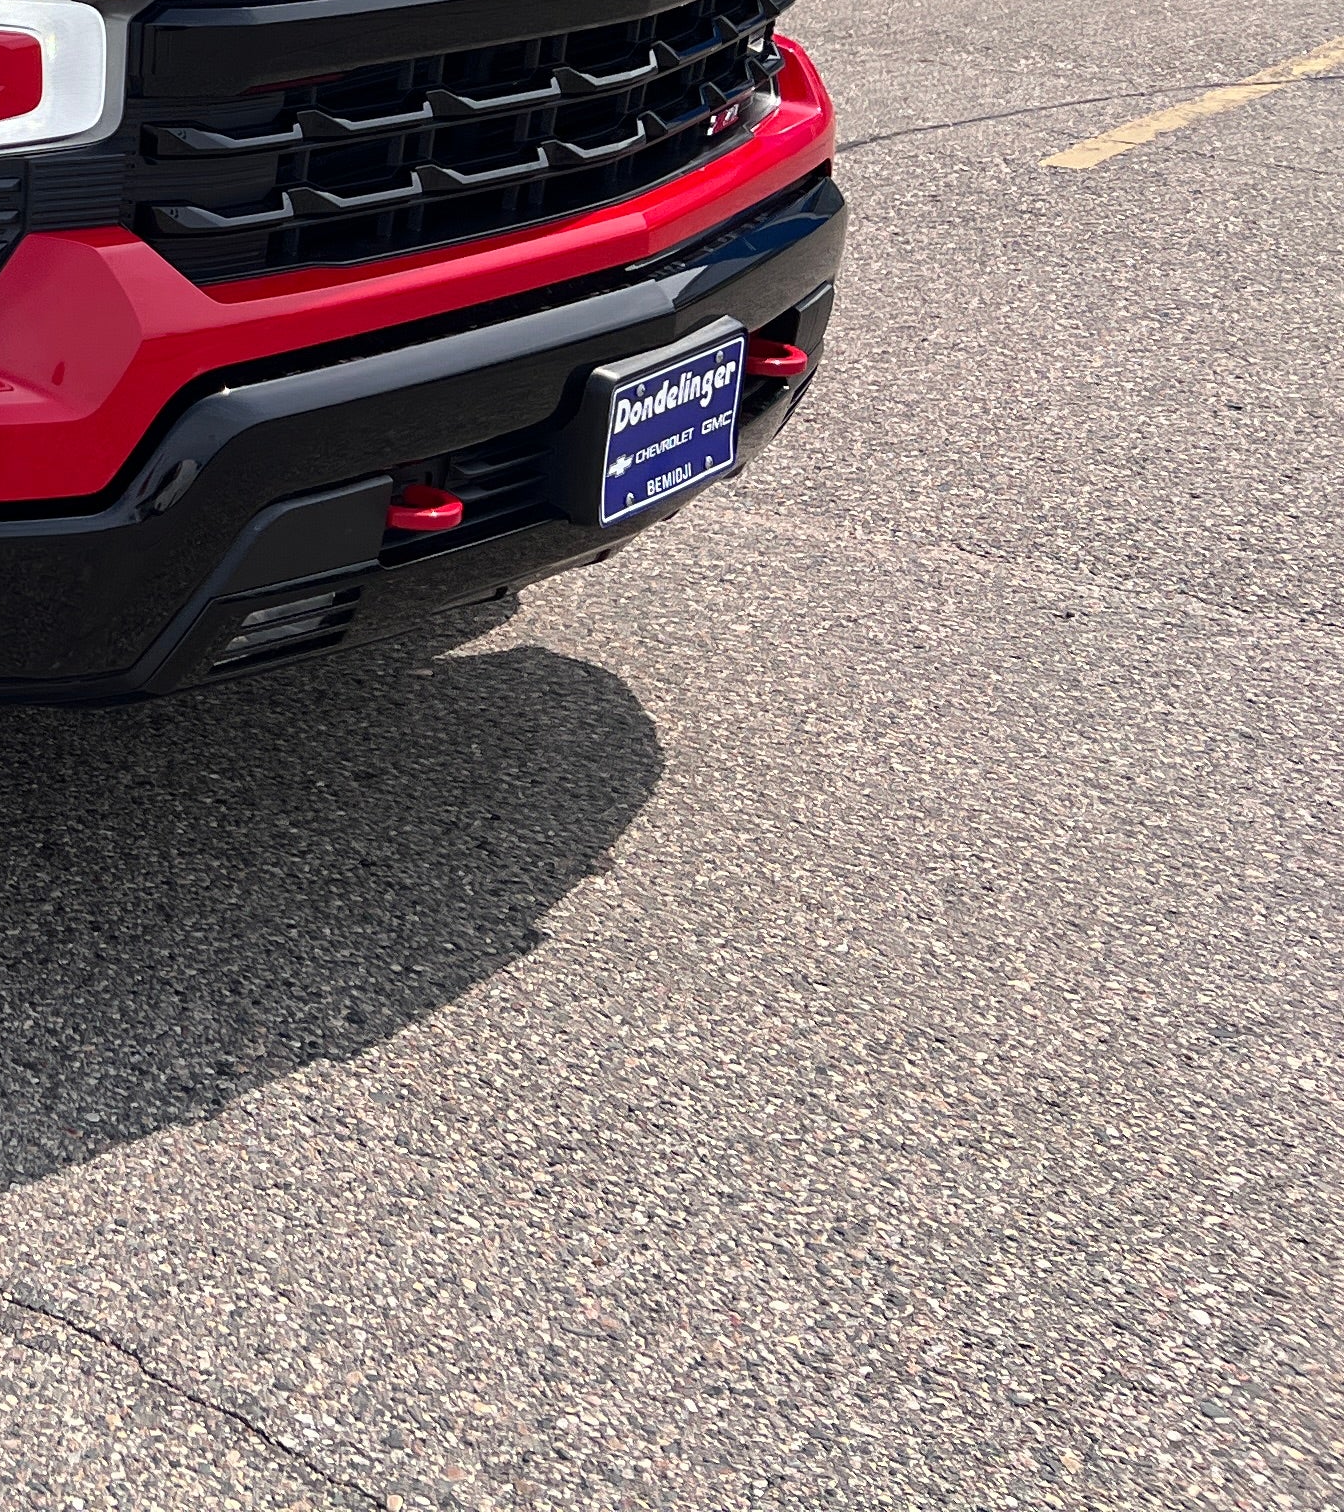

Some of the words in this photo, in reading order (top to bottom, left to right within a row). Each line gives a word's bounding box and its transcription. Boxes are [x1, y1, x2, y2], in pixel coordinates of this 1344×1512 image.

[613, 360, 737, 435] Dondelinger
[634, 426, 696, 464] CHEVROLET
[700, 409, 733, 435] GMC
[646, 461, 693, 497] BEMIDJI
